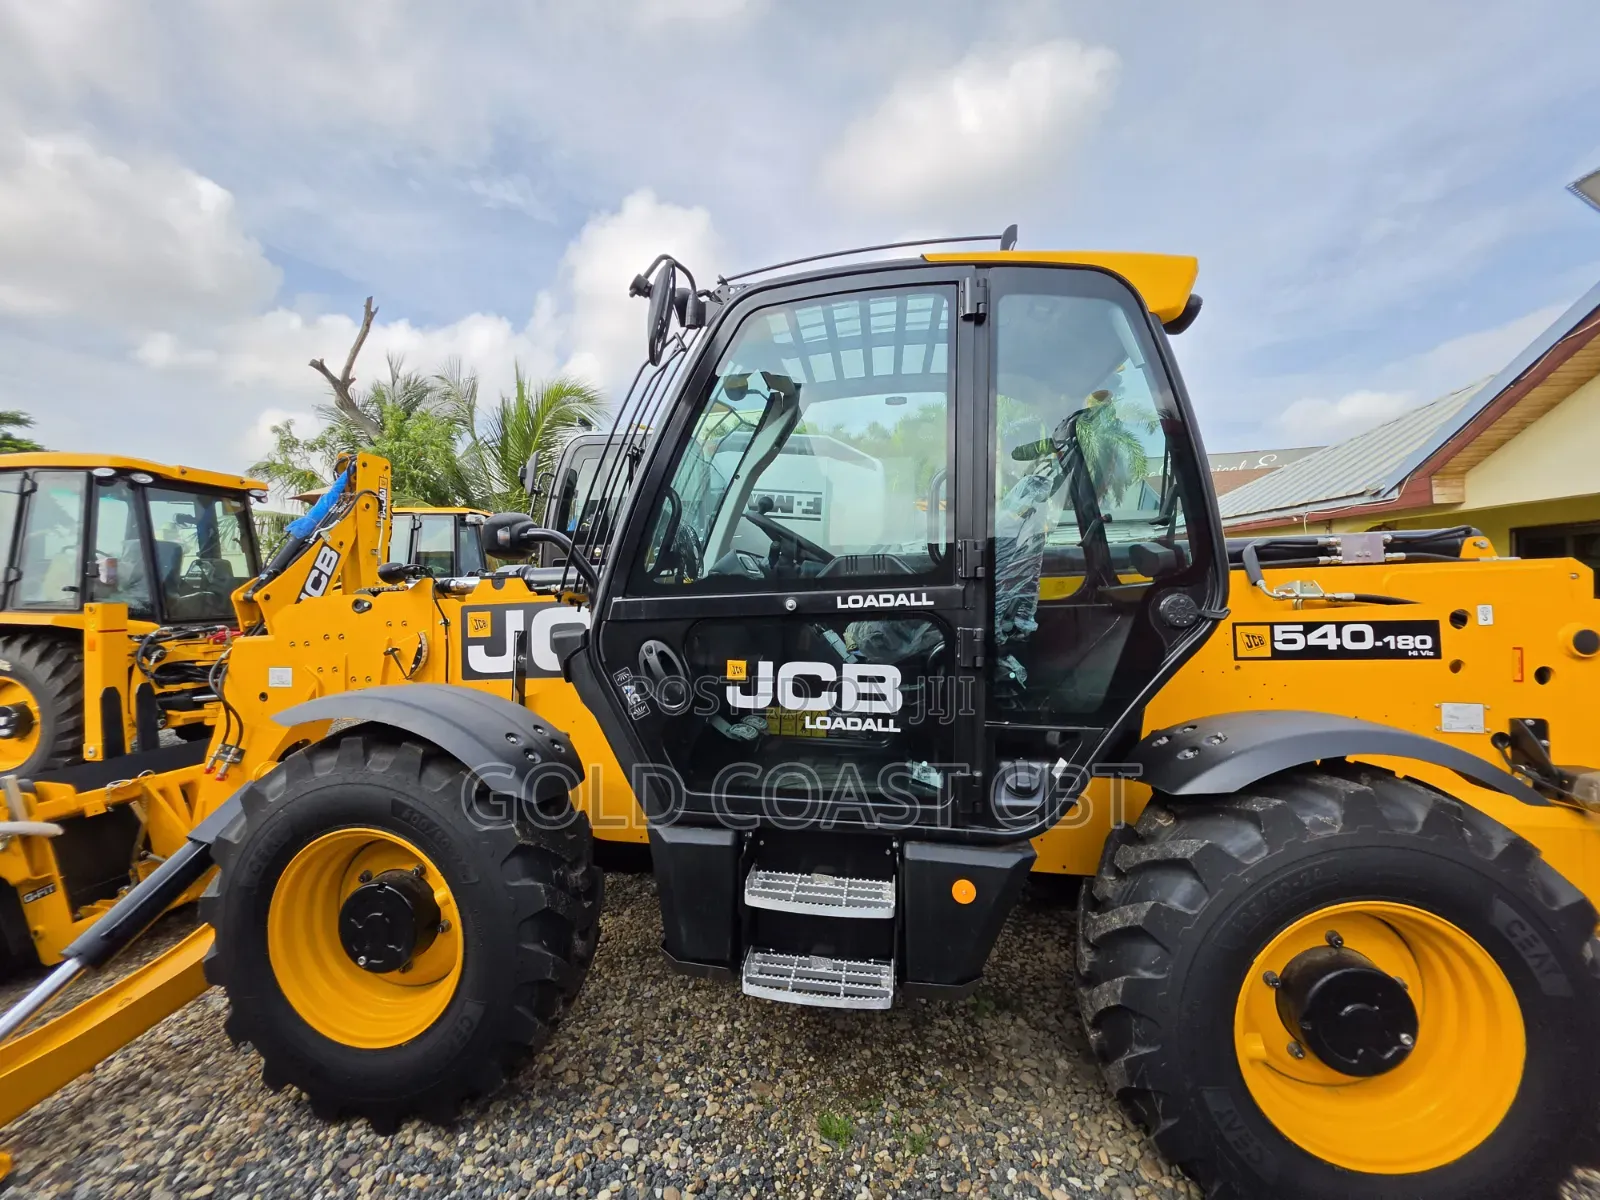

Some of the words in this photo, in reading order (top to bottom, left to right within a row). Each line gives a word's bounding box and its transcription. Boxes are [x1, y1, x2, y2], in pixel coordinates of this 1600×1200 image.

[836, 592, 935, 609] LOADALL
[467, 606, 592, 673] JC
[1244, 632, 1266, 650] JCB
[726, 660, 903, 714] JCB
[804, 715, 901, 733] LOADALL
